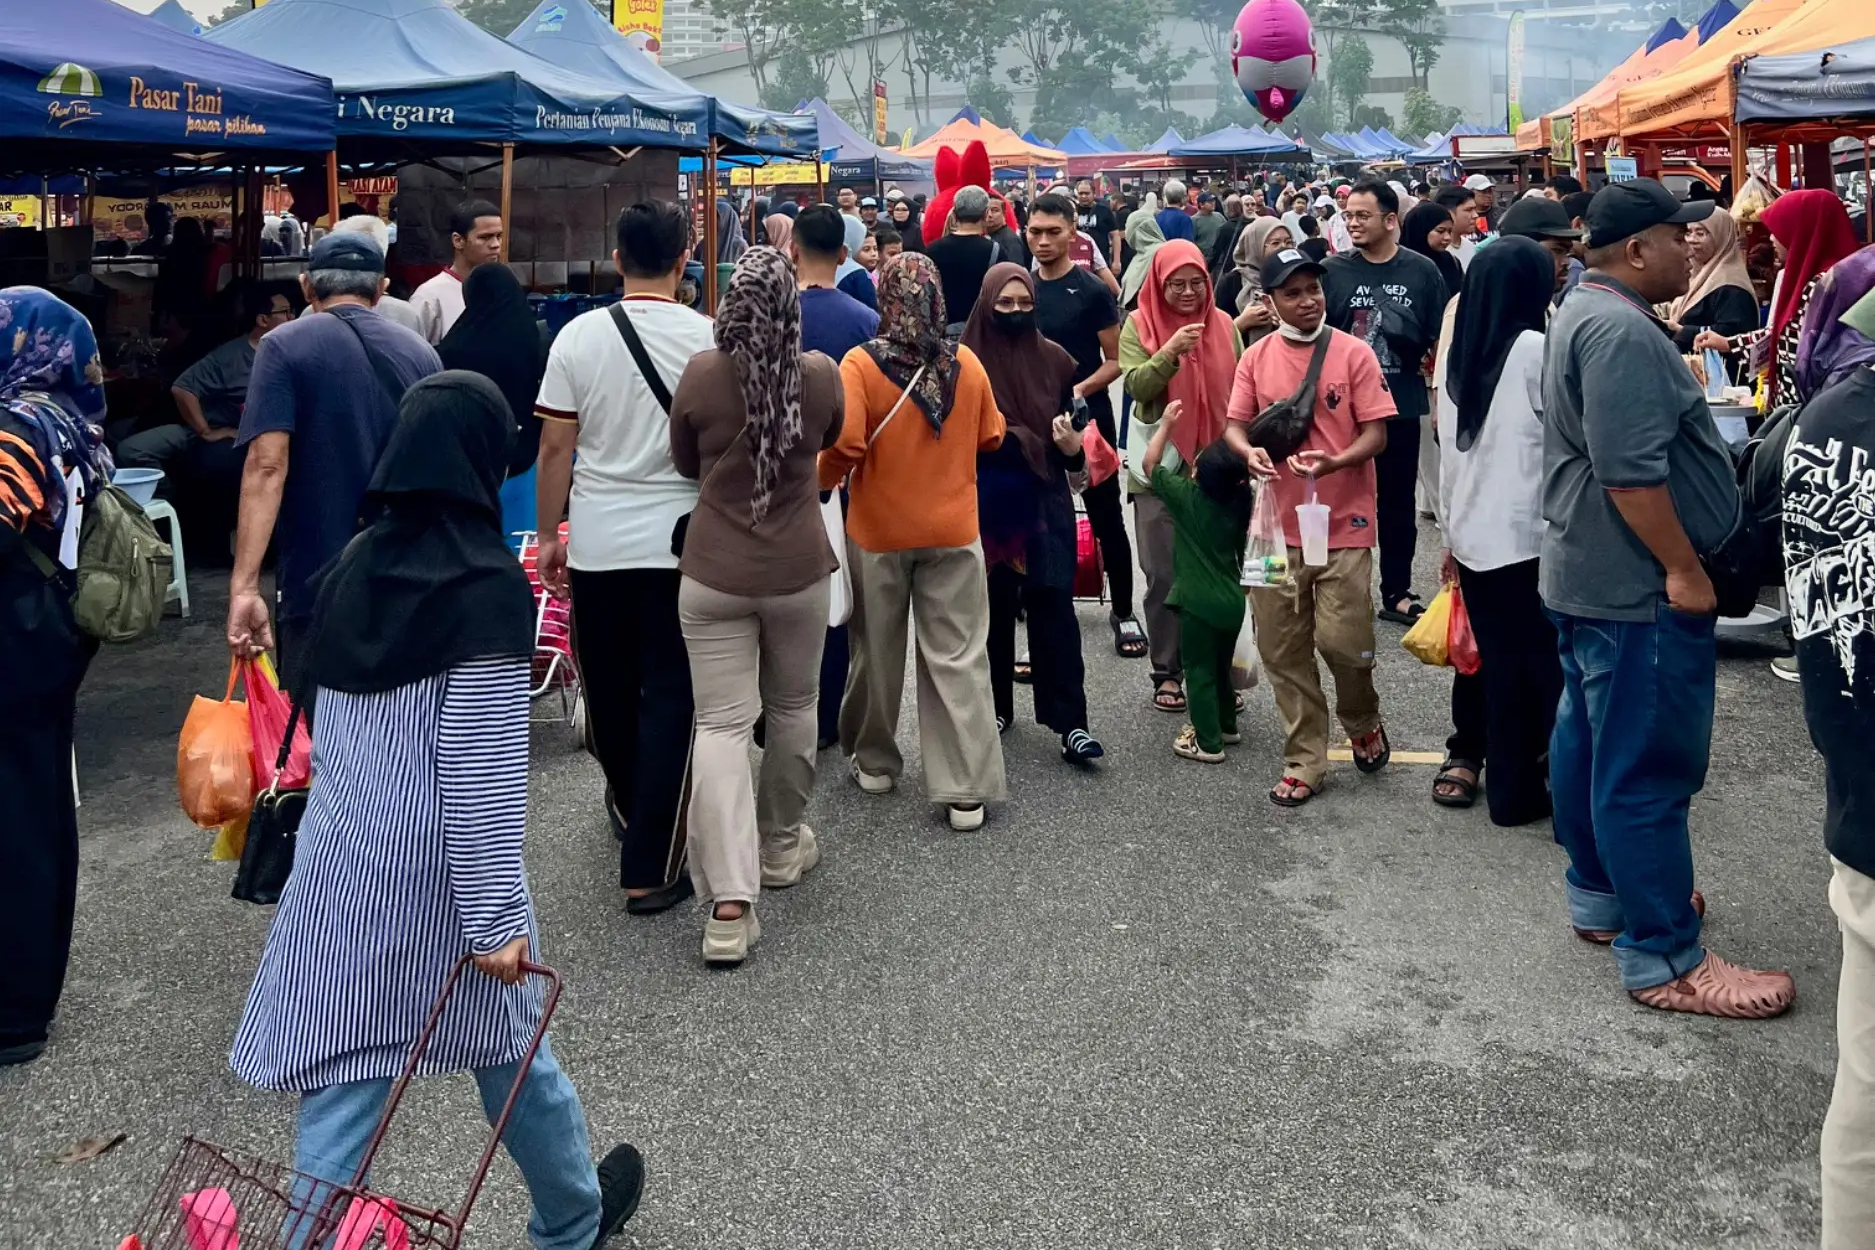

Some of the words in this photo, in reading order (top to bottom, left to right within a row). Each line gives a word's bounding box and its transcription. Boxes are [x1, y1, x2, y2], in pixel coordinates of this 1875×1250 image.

[129, 76, 180, 111] Pasar
[183, 81, 223, 115] Tani
[185, 115, 221, 137] pasar
[224, 115, 267, 139] pilihan
[356, 95, 456, 131] Negara
[536, 104, 589, 129] Pertanian
[592, 106, 631, 136] Penjana
[831, 165, 861, 177] Negara
[1356, 283, 1408, 296] AVGED
